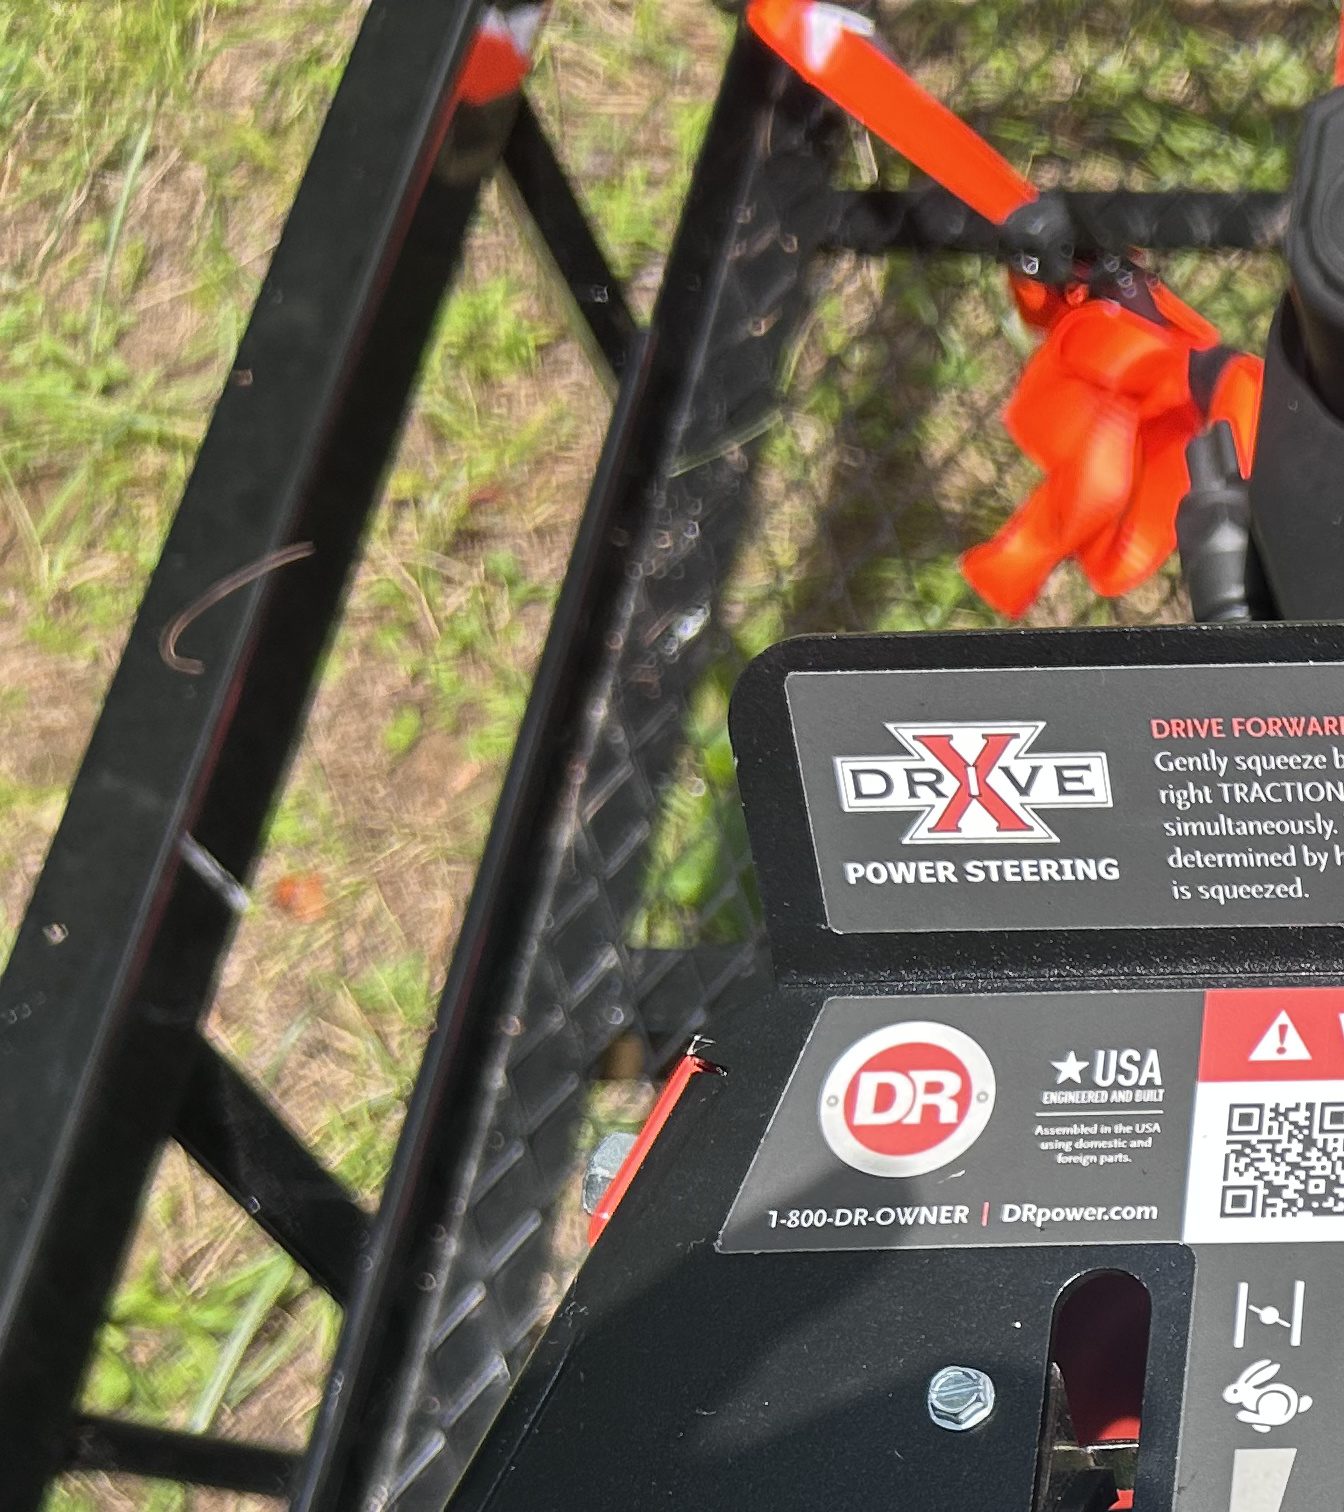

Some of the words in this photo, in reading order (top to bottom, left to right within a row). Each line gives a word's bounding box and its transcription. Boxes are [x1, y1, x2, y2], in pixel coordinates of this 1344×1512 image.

[1150, 718, 1223, 738] DRIVE
[1155, 749, 1228, 777] Gently
[1235, 755, 1326, 776] squeeze
[1160, 782, 1213, 810] right
[1217, 782, 1344, 803] TRACTION
[1164, 813, 1338, 840] simultaneously.
[845, 861, 958, 884] POWER
[964, 858, 1119, 882] STEERING
[1094, 1049, 1161, 1087] USA
[852, 1069, 962, 1125] DR
[1035, 1124, 1098, 1135] Assembled
[1100, 1125, 1111, 1133] in
[1114, 1123, 1133, 1133] the
[1135, 1123, 1161, 1133] USA
[1040, 1140, 1072, 1152] using
[1074, 1138, 1127, 1148] domestic
[1129, 1137, 1152, 1147] and
[769, 1205, 969, 1228] 1-800-DR-OWNER
[1002, 1204, 1157, 1227] DRpower.com
